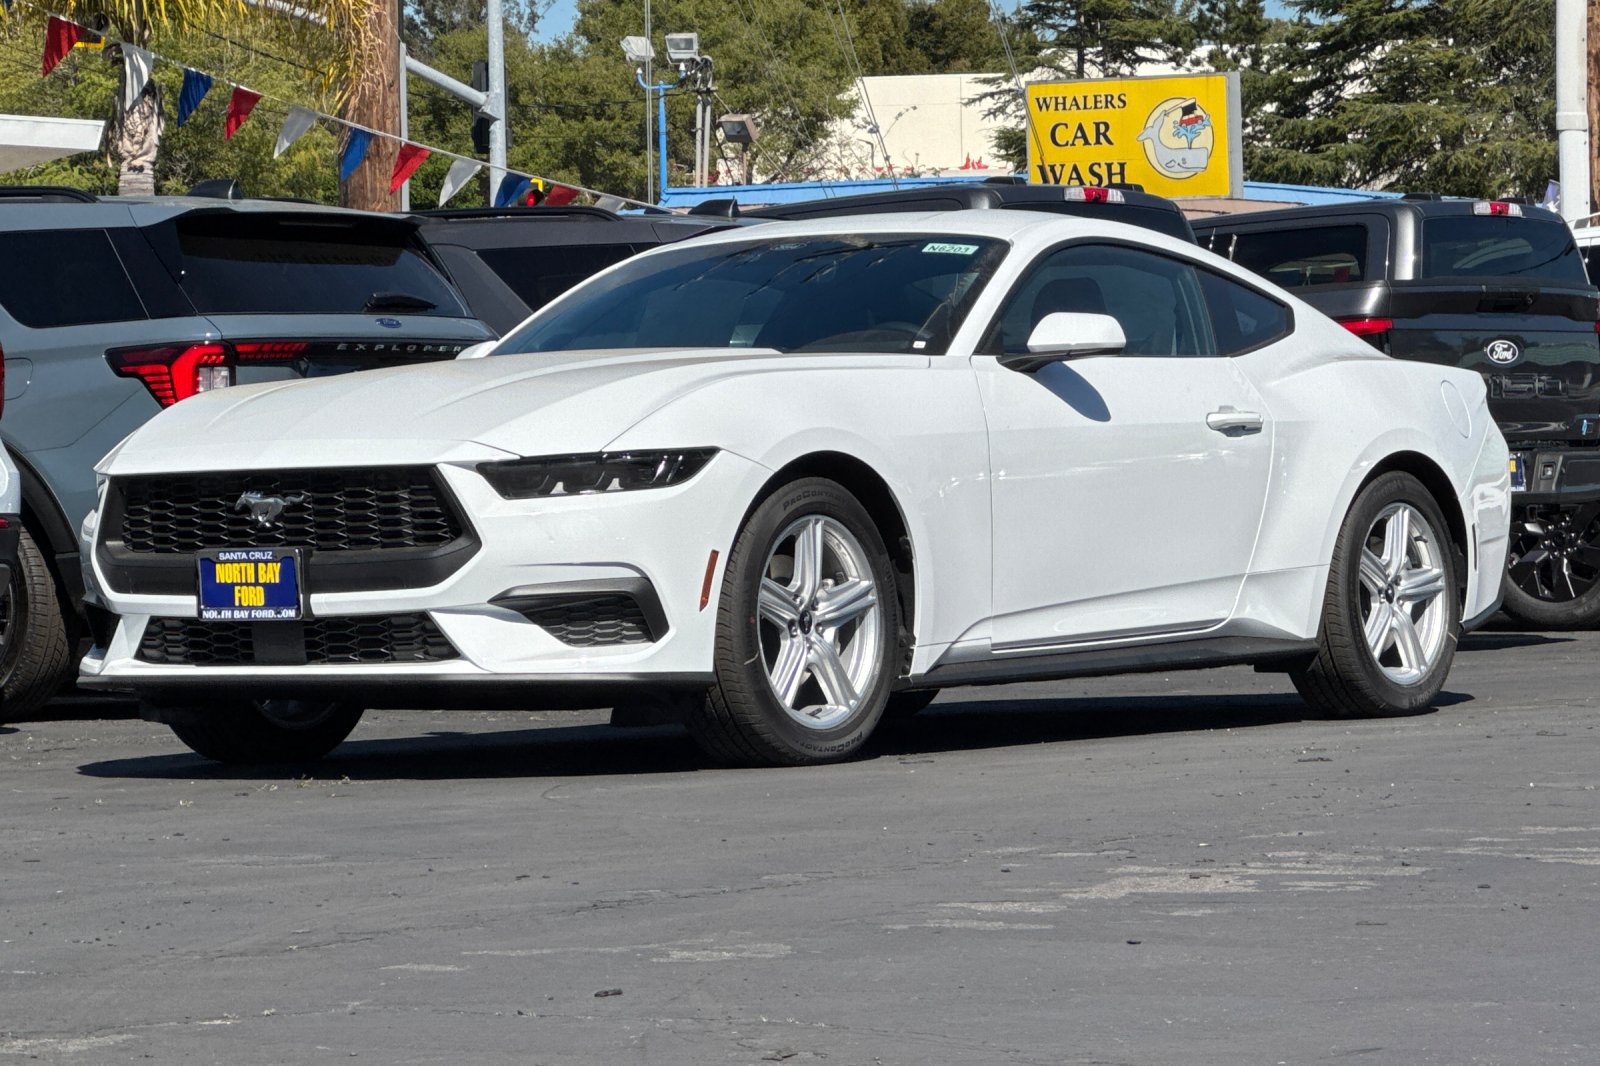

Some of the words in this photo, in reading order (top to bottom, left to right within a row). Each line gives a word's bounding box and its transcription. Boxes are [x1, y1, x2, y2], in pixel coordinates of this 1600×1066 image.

[1036, 93, 1127, 112] WHALERS
[1051, 121, 1114, 147] CAR
[1037, 162, 1127, 186] WASH
[337, 343, 461, 352] EXPLORER
[1493, 344, 1513, 360] Ford
[219, 551, 248, 560] SANTA
[249, 551, 273, 560] CRUZ
[215, 562, 255, 583] NORTH
[258, 562, 281, 583] BAY
[234, 585, 265, 606] FORD
[233, 609, 250, 619] BAY
